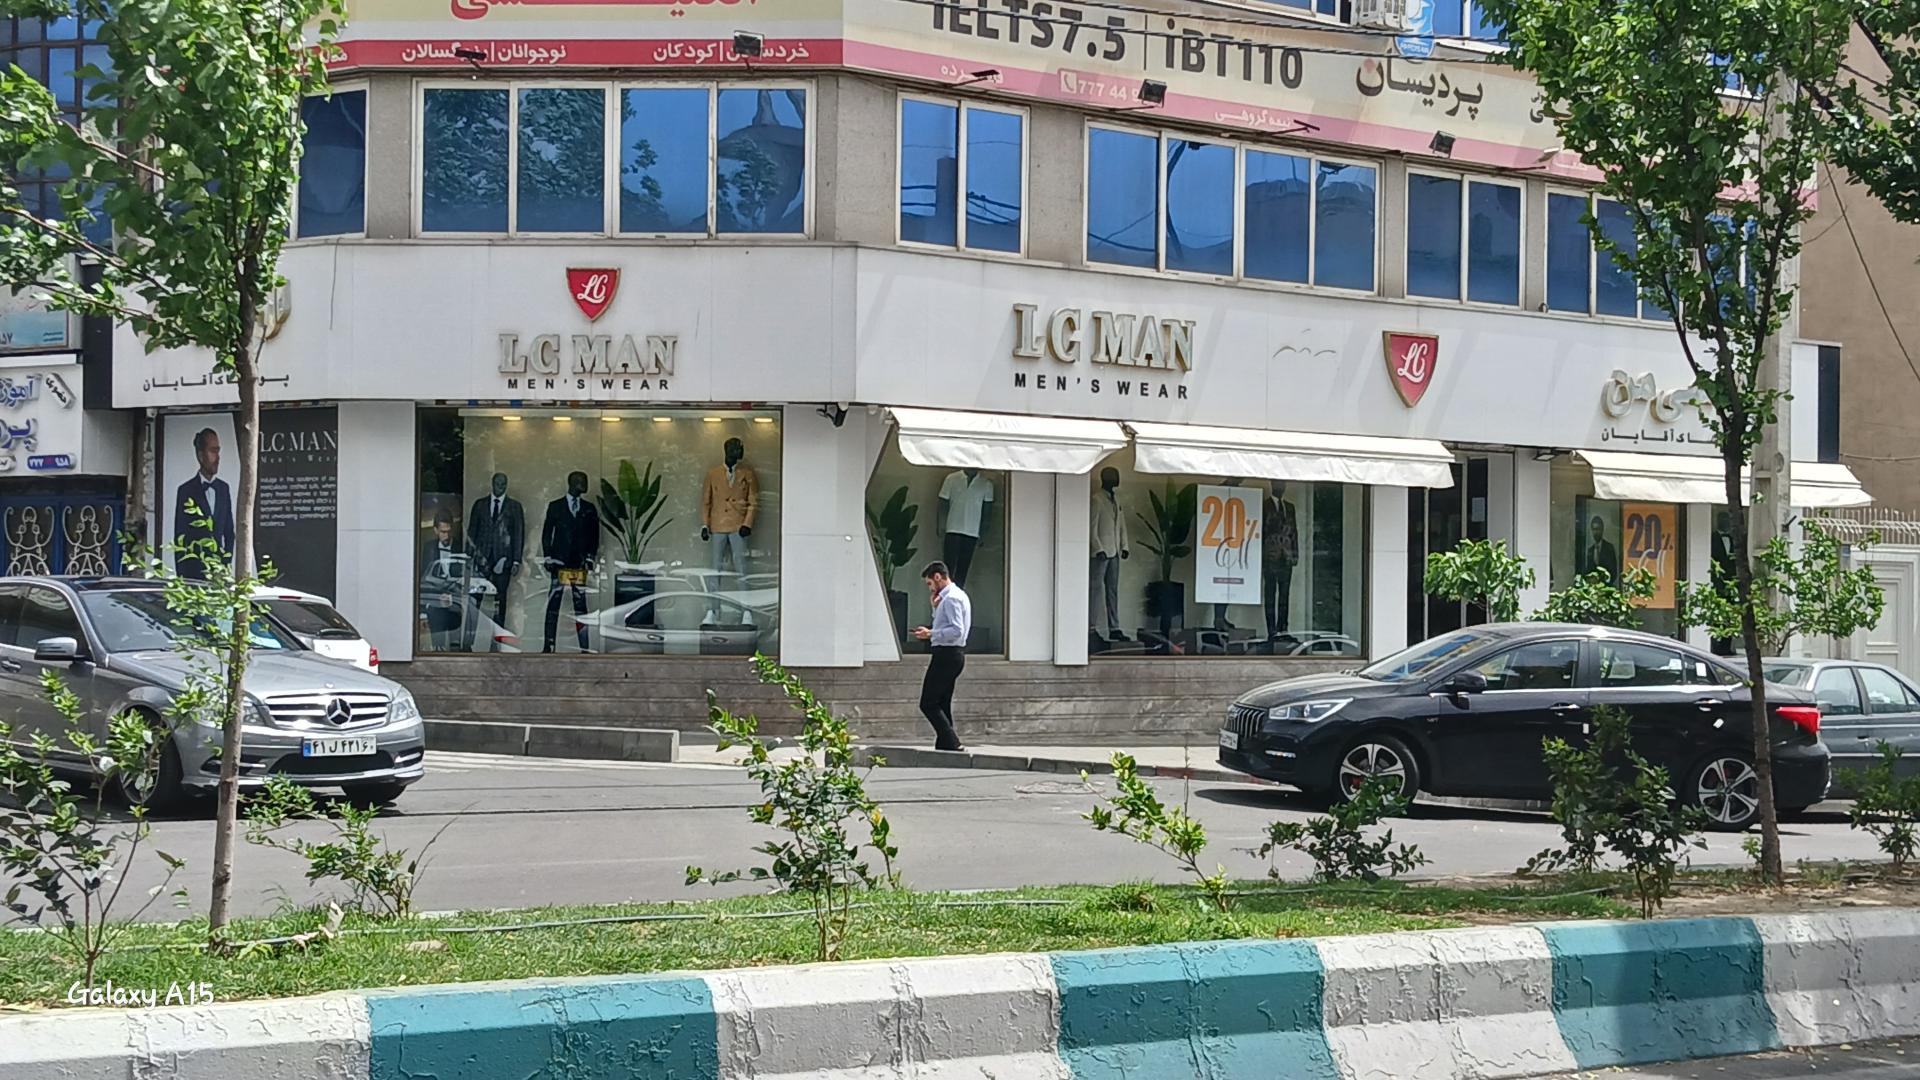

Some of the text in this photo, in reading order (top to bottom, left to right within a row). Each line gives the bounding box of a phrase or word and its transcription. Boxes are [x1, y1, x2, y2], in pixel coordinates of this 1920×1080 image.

[498, 44, 567, 64] نوجوانان
[653, 42, 717, 64] کودکان
[1356, 47, 1484, 121] پردیسان
[571, 335, 678, 376] MAN
[1091, 311, 1197, 375] MAN
[508, 379, 669, 390] MEN'S WEAR
[1014, 372, 1188, 400] MEN'S WEAR
[1202, 496, 1260, 548] 20%
